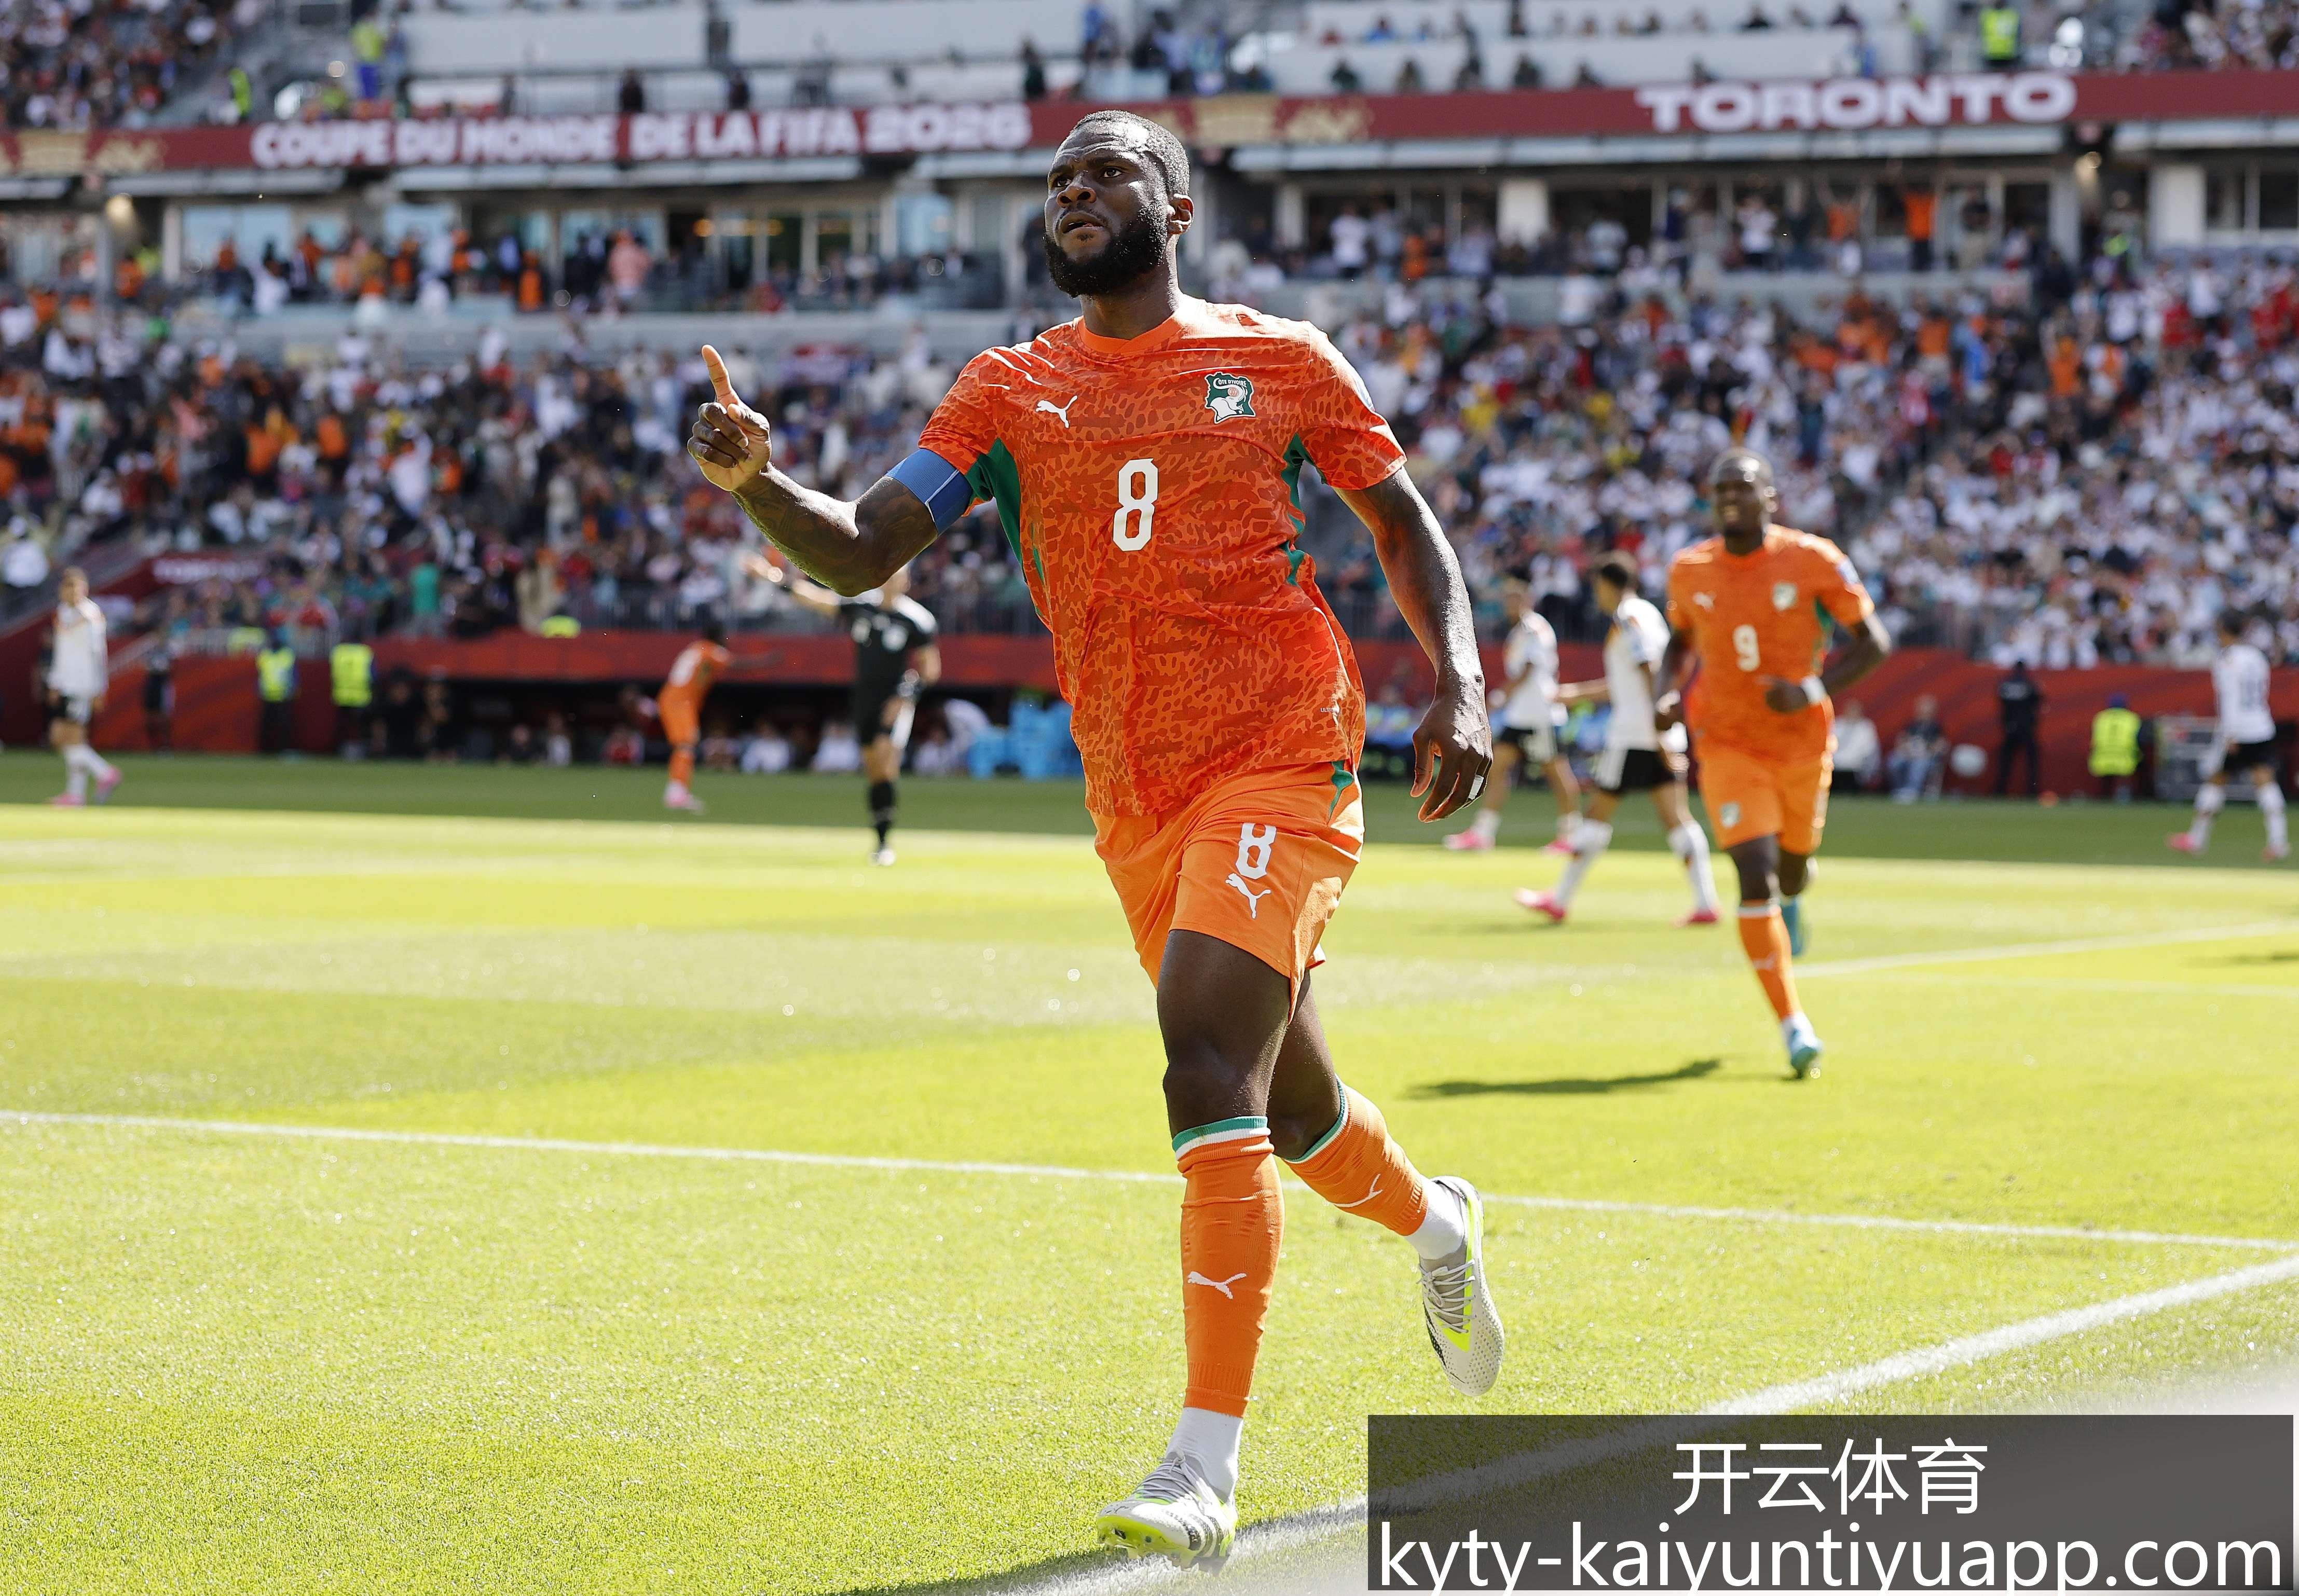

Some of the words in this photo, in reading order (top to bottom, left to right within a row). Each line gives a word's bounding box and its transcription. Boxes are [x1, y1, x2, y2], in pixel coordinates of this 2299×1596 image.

[1636, 74, 2075, 132] TORONTO
[251, 119, 391, 168] COUPE
[397, 117, 457, 165] DU
[462, 116, 617, 163] MONDE
[630, 113, 689, 159] DE
[696, 112, 753, 156] LA
[758, 108, 859, 156] FIFA
[865, 104, 1031, 150] 2026
[1113, 458, 1158, 552] 8
[1734, 625, 1760, 671] 9
[1236, 823, 1277, 879] 8
